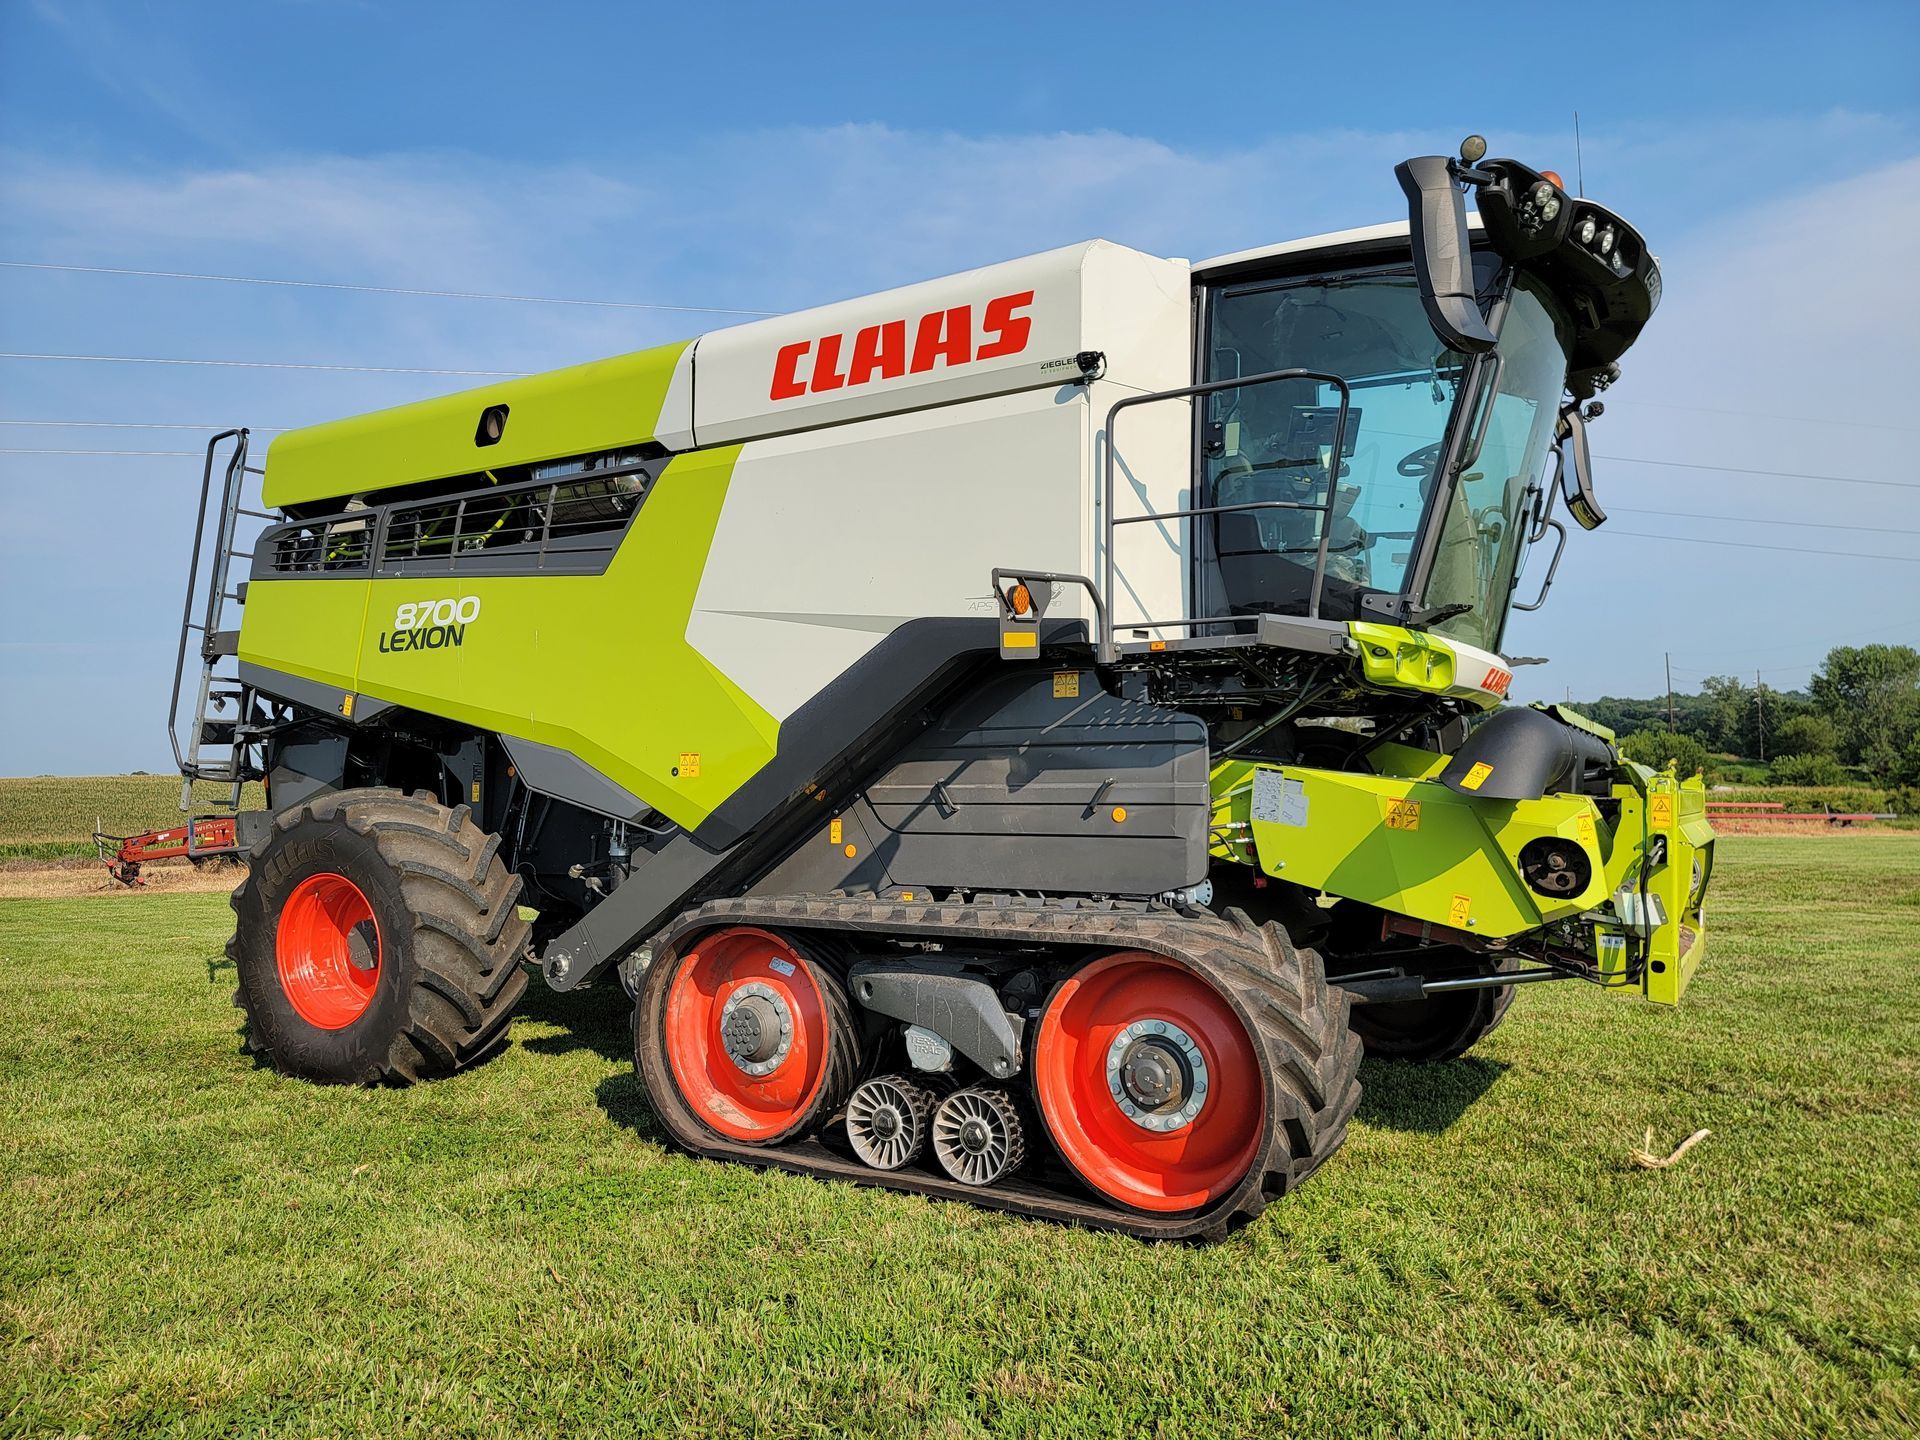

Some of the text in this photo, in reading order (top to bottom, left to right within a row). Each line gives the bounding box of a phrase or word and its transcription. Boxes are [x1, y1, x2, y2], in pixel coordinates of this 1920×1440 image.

[770, 290, 1034, 400] CLAAS
[395, 596, 480, 630] 8700
[968, 601, 994, 612] APS
[379, 624, 465, 653] LEXION
